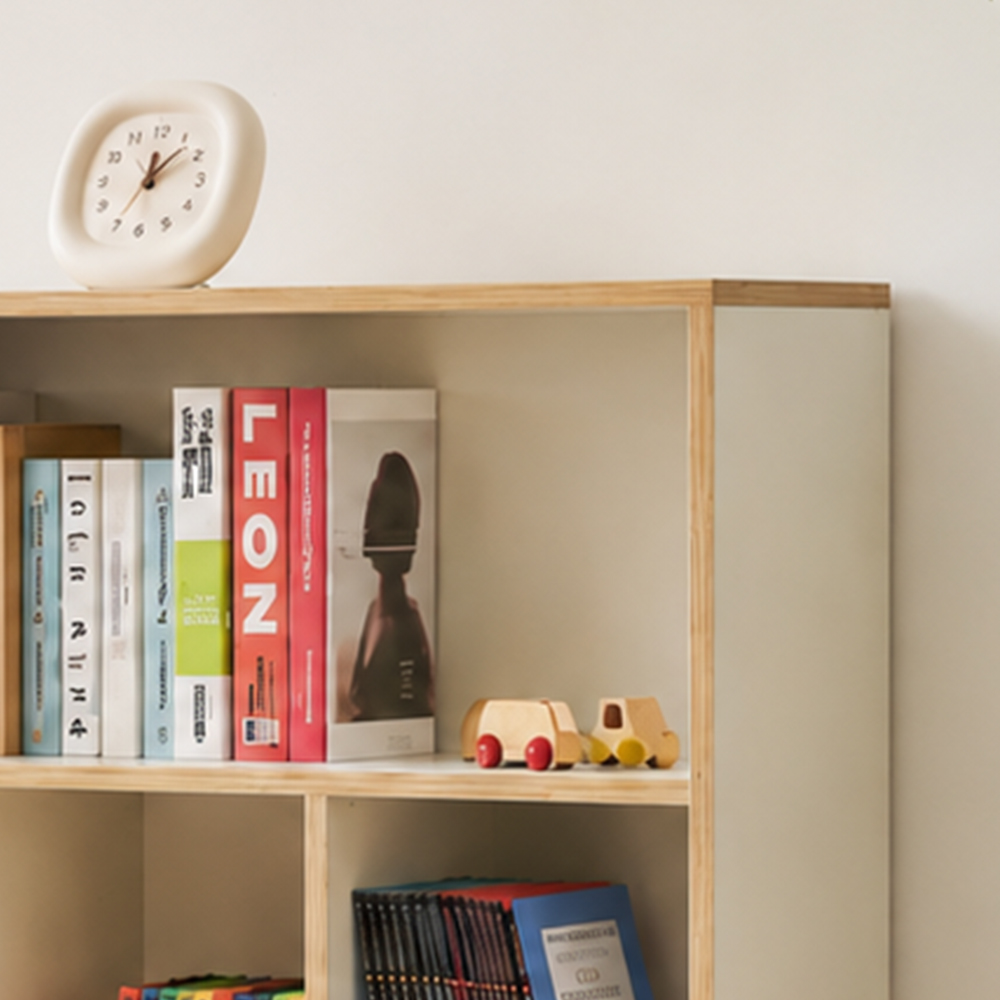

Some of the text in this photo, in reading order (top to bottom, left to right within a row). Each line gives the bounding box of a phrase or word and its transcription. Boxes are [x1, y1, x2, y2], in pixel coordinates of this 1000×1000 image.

[154, 125, 171, 139] 12
[111, 218, 122, 232] 7
[133, 222, 145, 238] 6
[242, 403, 278, 635] LEON
